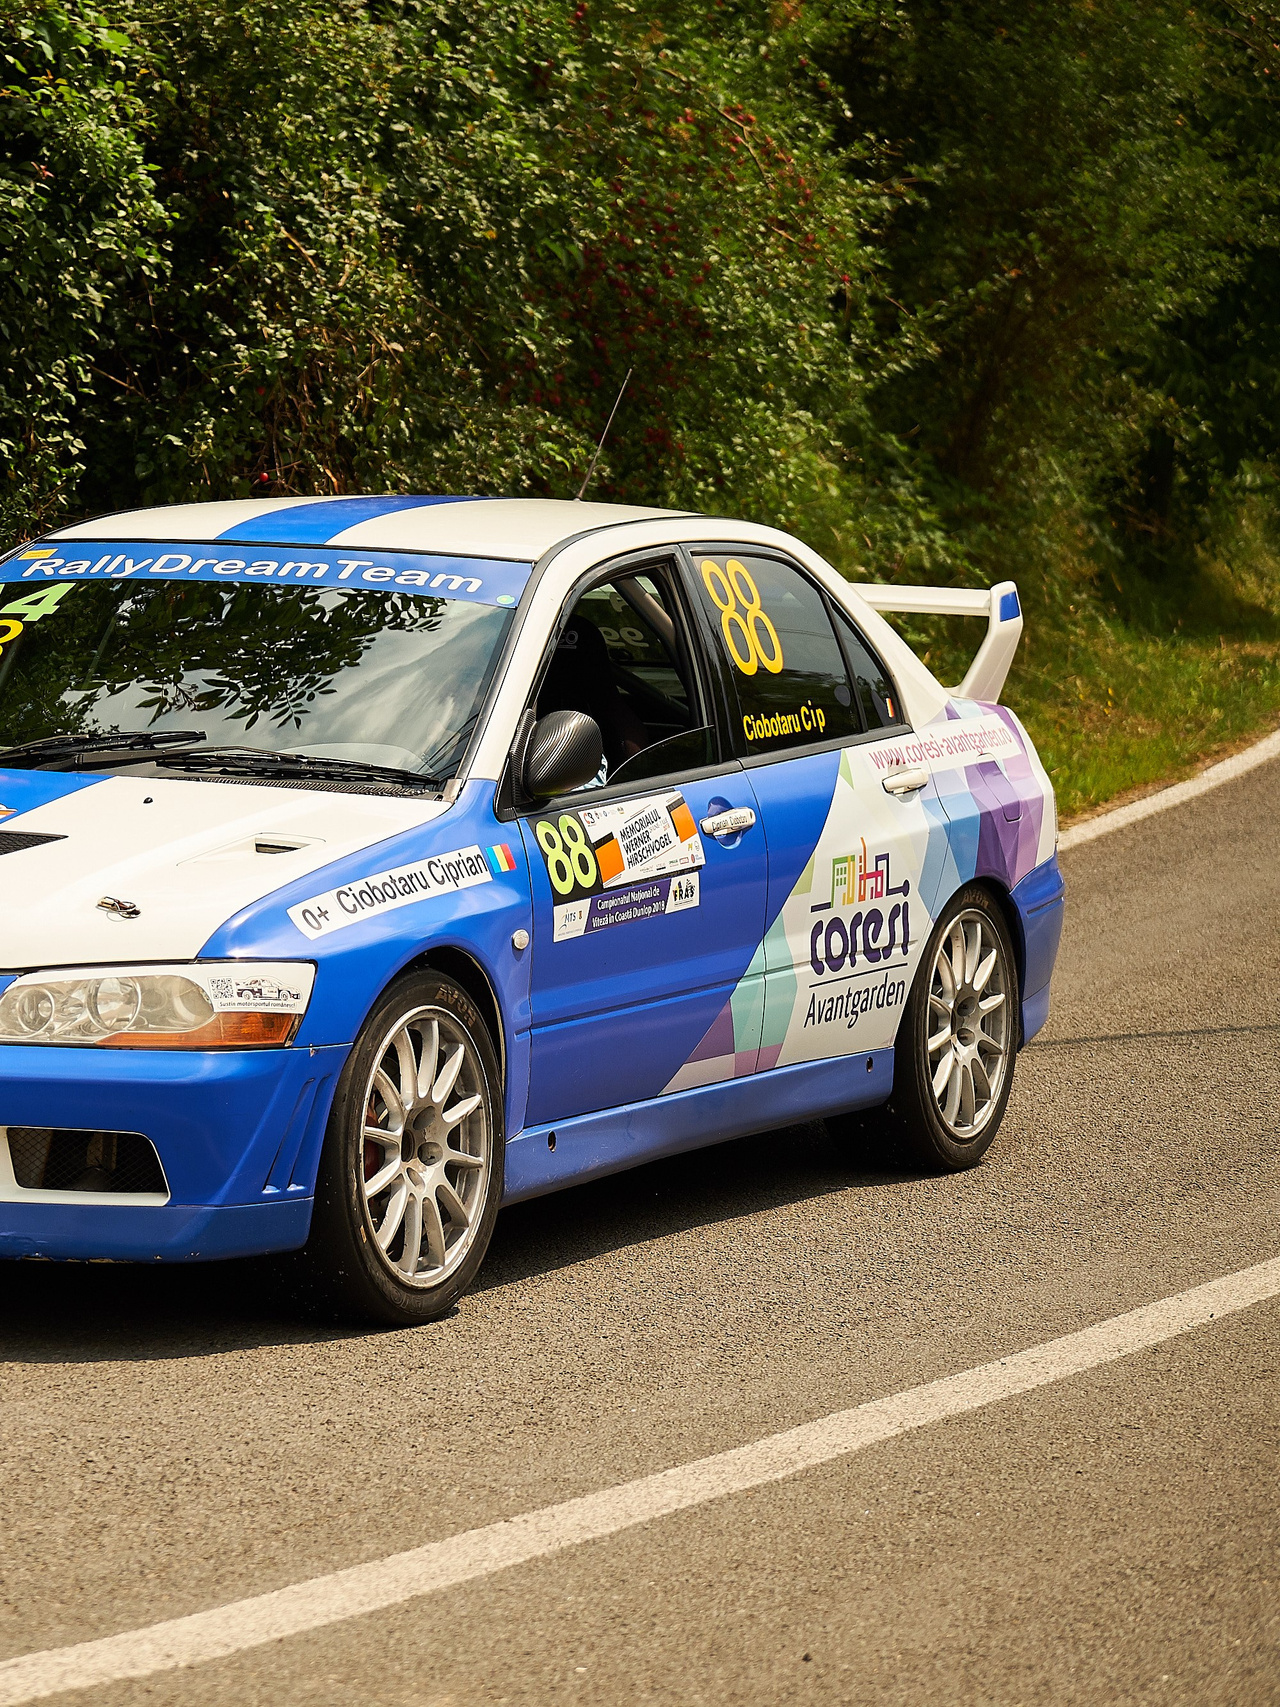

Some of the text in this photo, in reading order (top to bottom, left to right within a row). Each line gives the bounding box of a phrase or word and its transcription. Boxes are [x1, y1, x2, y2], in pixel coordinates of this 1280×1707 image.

[701, 560, 784, 675] 88
[743, 700, 826, 741] Ciobotaru Cip
[868, 724, 1013, 770] www.coresi-avantgarden.ro
[619, 808, 661, 842] MEMORIALUL
[622, 830, 652, 856] WERNER
[536, 814, 597, 895] 88
[626, 832, 672, 870] HIRSCHVOGEL
[336, 870, 431, 914] Ciobotaru
[428, 852, 489, 888] Ciprian
[597, 892, 631, 911] Campionatul
[652, 887, 660, 899] de
[632, 905, 652, 919] Dunlop
[810, 901, 910, 976] coresi
[803, 972, 906, 1029] Avantgarden
